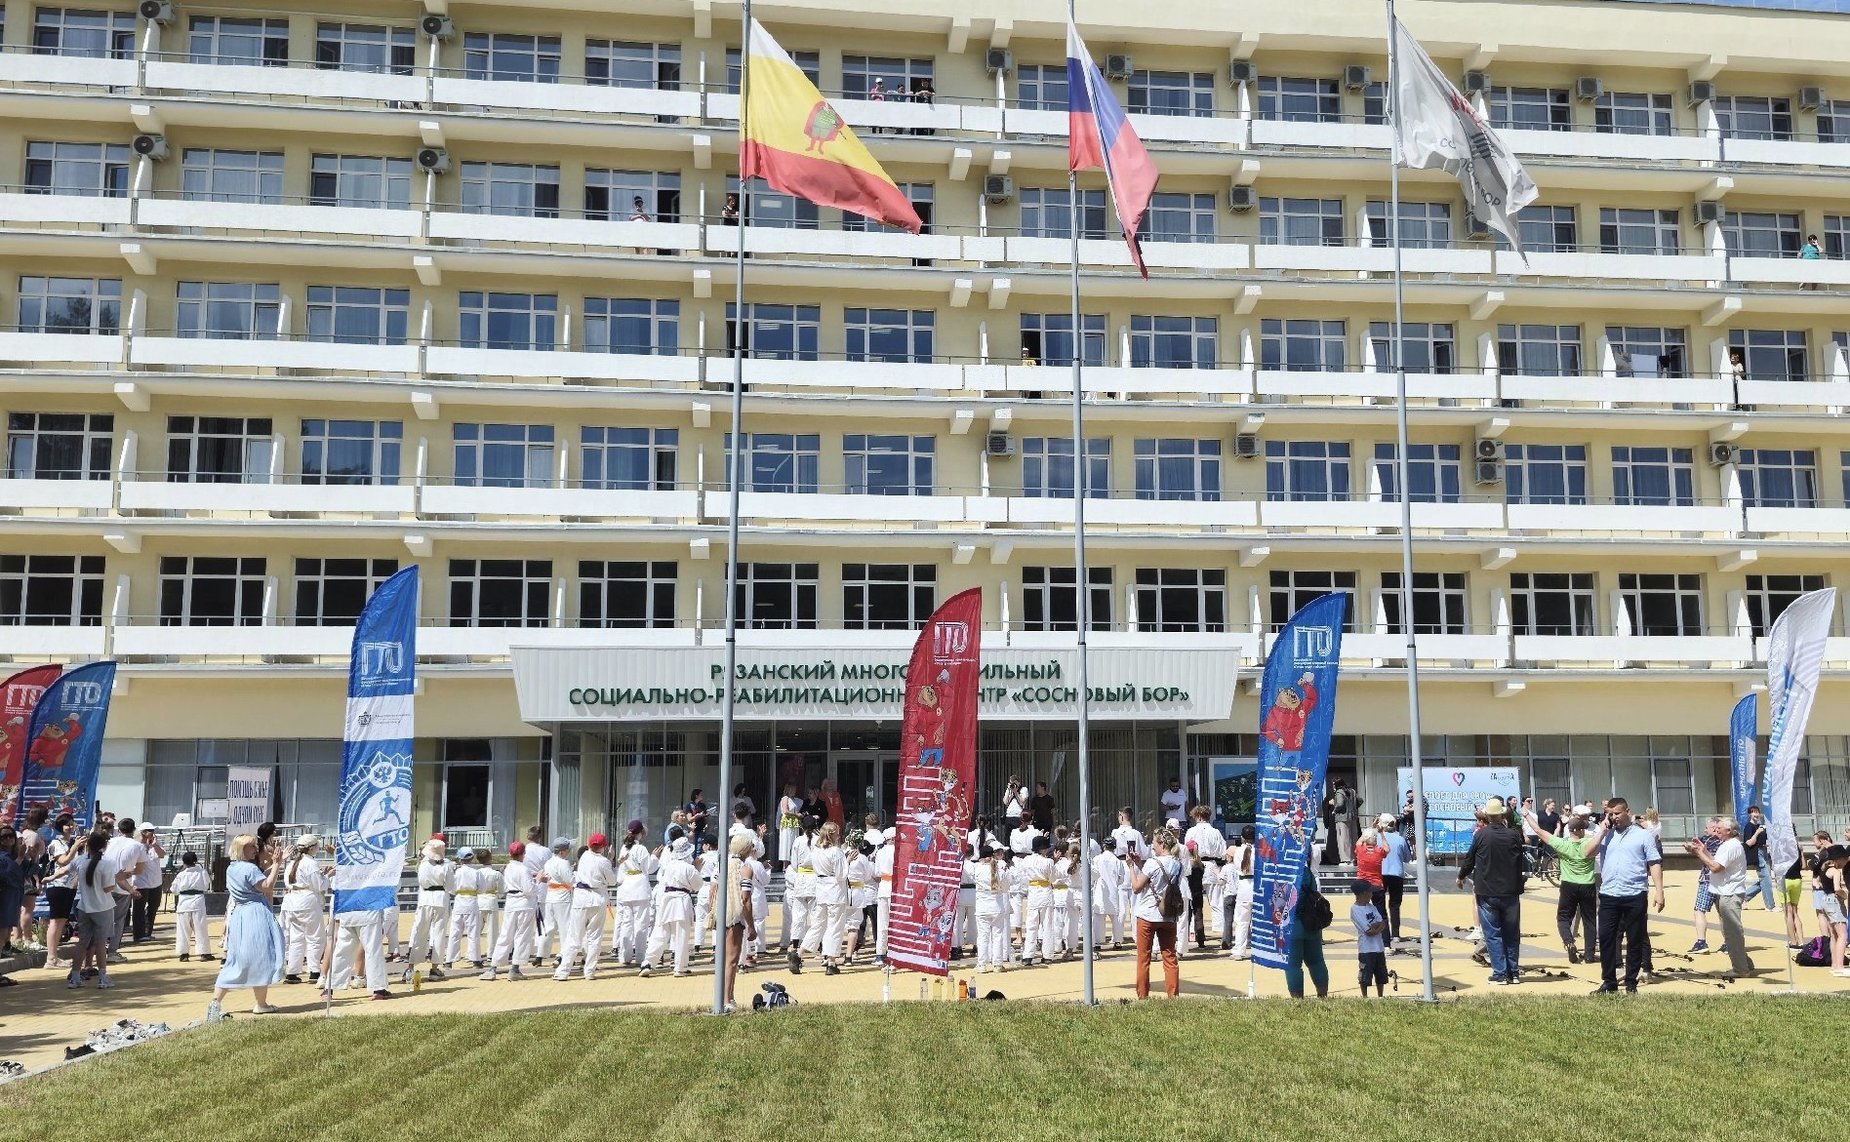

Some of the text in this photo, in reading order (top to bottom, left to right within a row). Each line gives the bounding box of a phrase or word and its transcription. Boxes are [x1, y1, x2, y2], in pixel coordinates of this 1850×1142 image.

[934, 621, 969, 654] ГТО
[1294, 626, 1333, 658] ГТО
[360, 641, 404, 676] ГТО
[711, 660, 835, 680] РЗАНСКИЙ
[840, 660, 1061, 680] МНОГОИЛЬНЫЙ
[61, 681, 102, 704] ГТО
[569, 687, 907, 706] СОЦИАЛЬНО-РАБИЛИТАЦИОНН
[977, 687, 1007, 703] НТР
[1142, 686, 1189, 703] БОР»
[379, 828, 409, 847] ГТО
